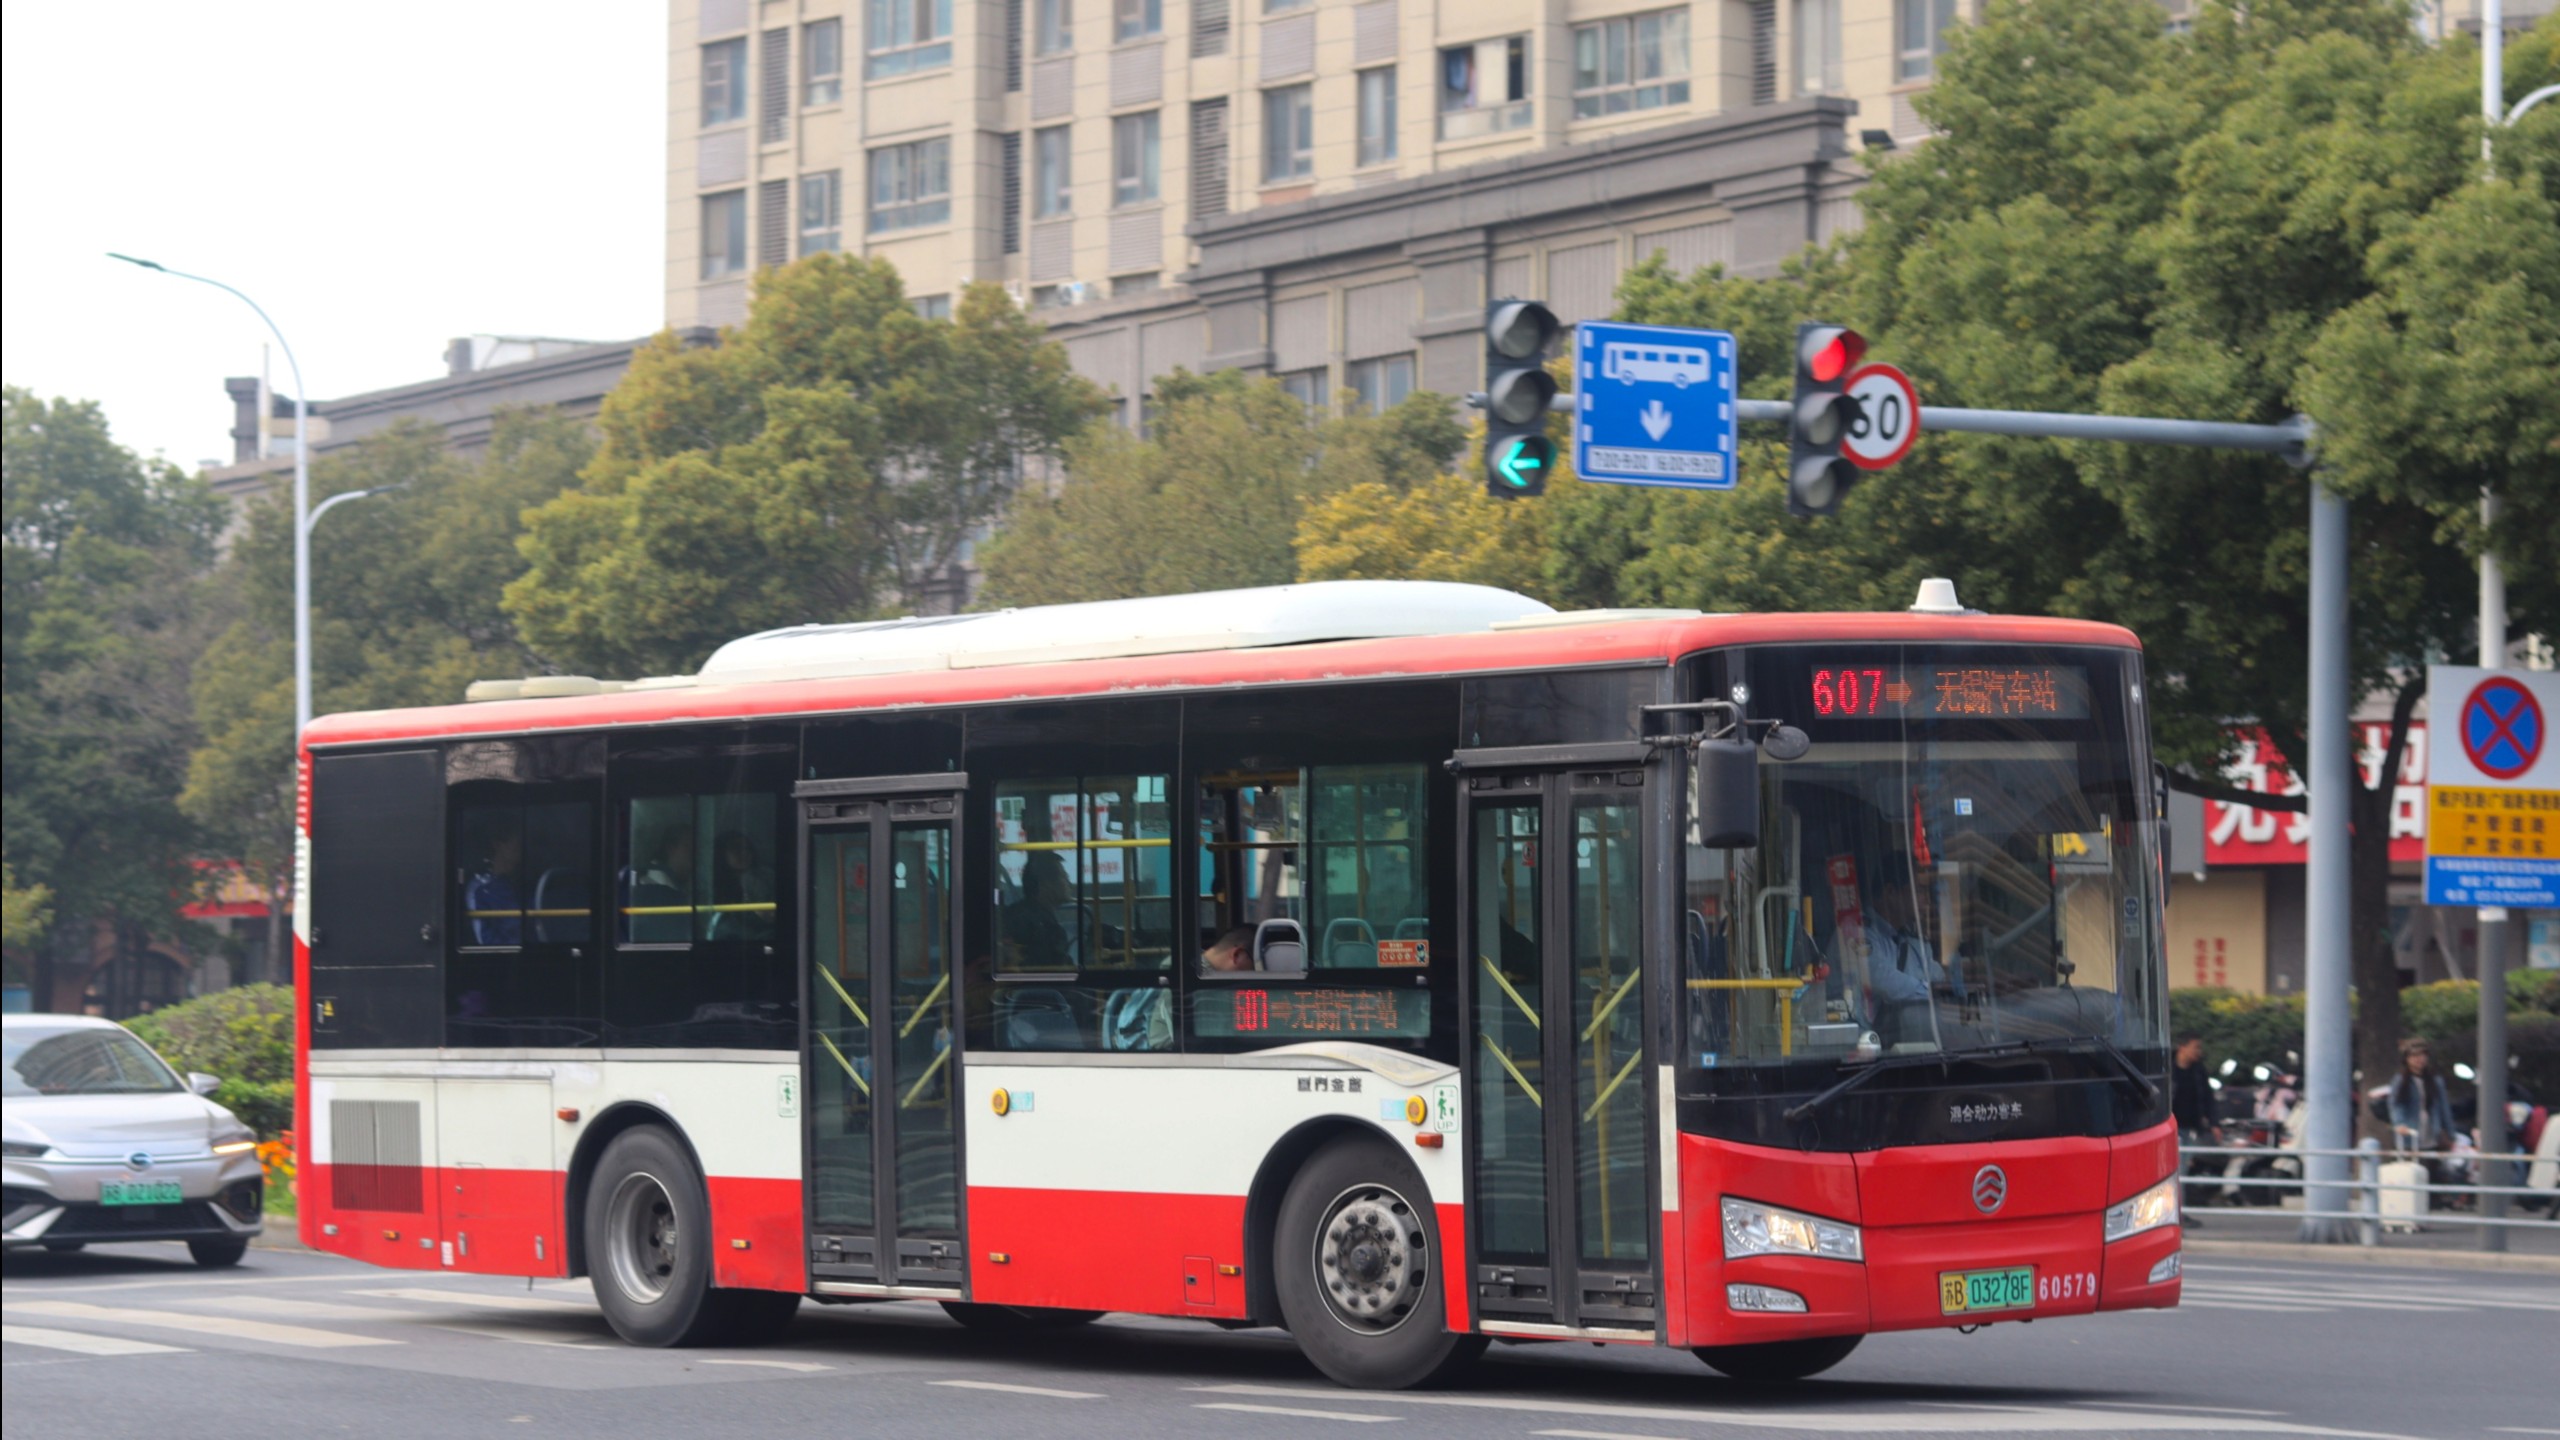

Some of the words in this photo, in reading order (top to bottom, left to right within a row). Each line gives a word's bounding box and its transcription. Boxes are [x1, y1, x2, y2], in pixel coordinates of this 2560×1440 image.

[1812, 670, 1883, 715] 607
[1935, 670, 2057, 714] 无锡汽车站
[2039, 1272, 2096, 1301] 60579
